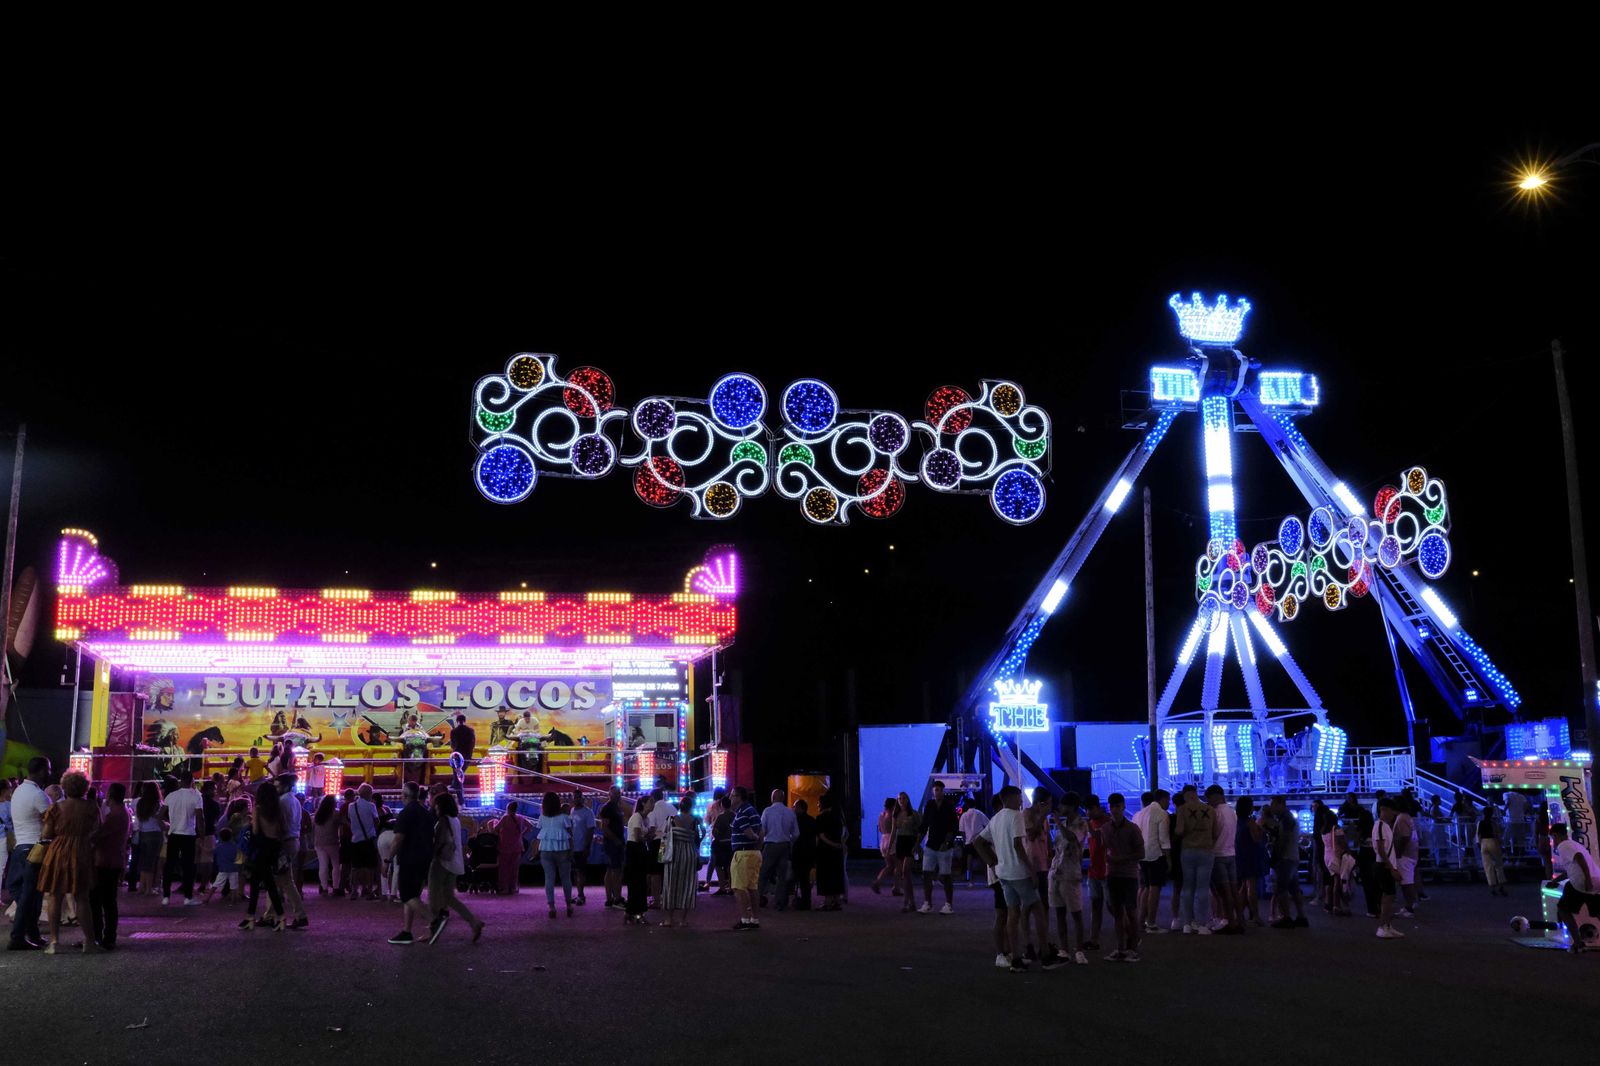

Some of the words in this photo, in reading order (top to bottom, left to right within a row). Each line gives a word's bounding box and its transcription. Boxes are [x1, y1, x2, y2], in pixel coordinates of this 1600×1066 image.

[202, 676, 420, 709] BUFALOS
[442, 679, 597, 709] LOCOS
[993, 706, 1046, 728] THE
